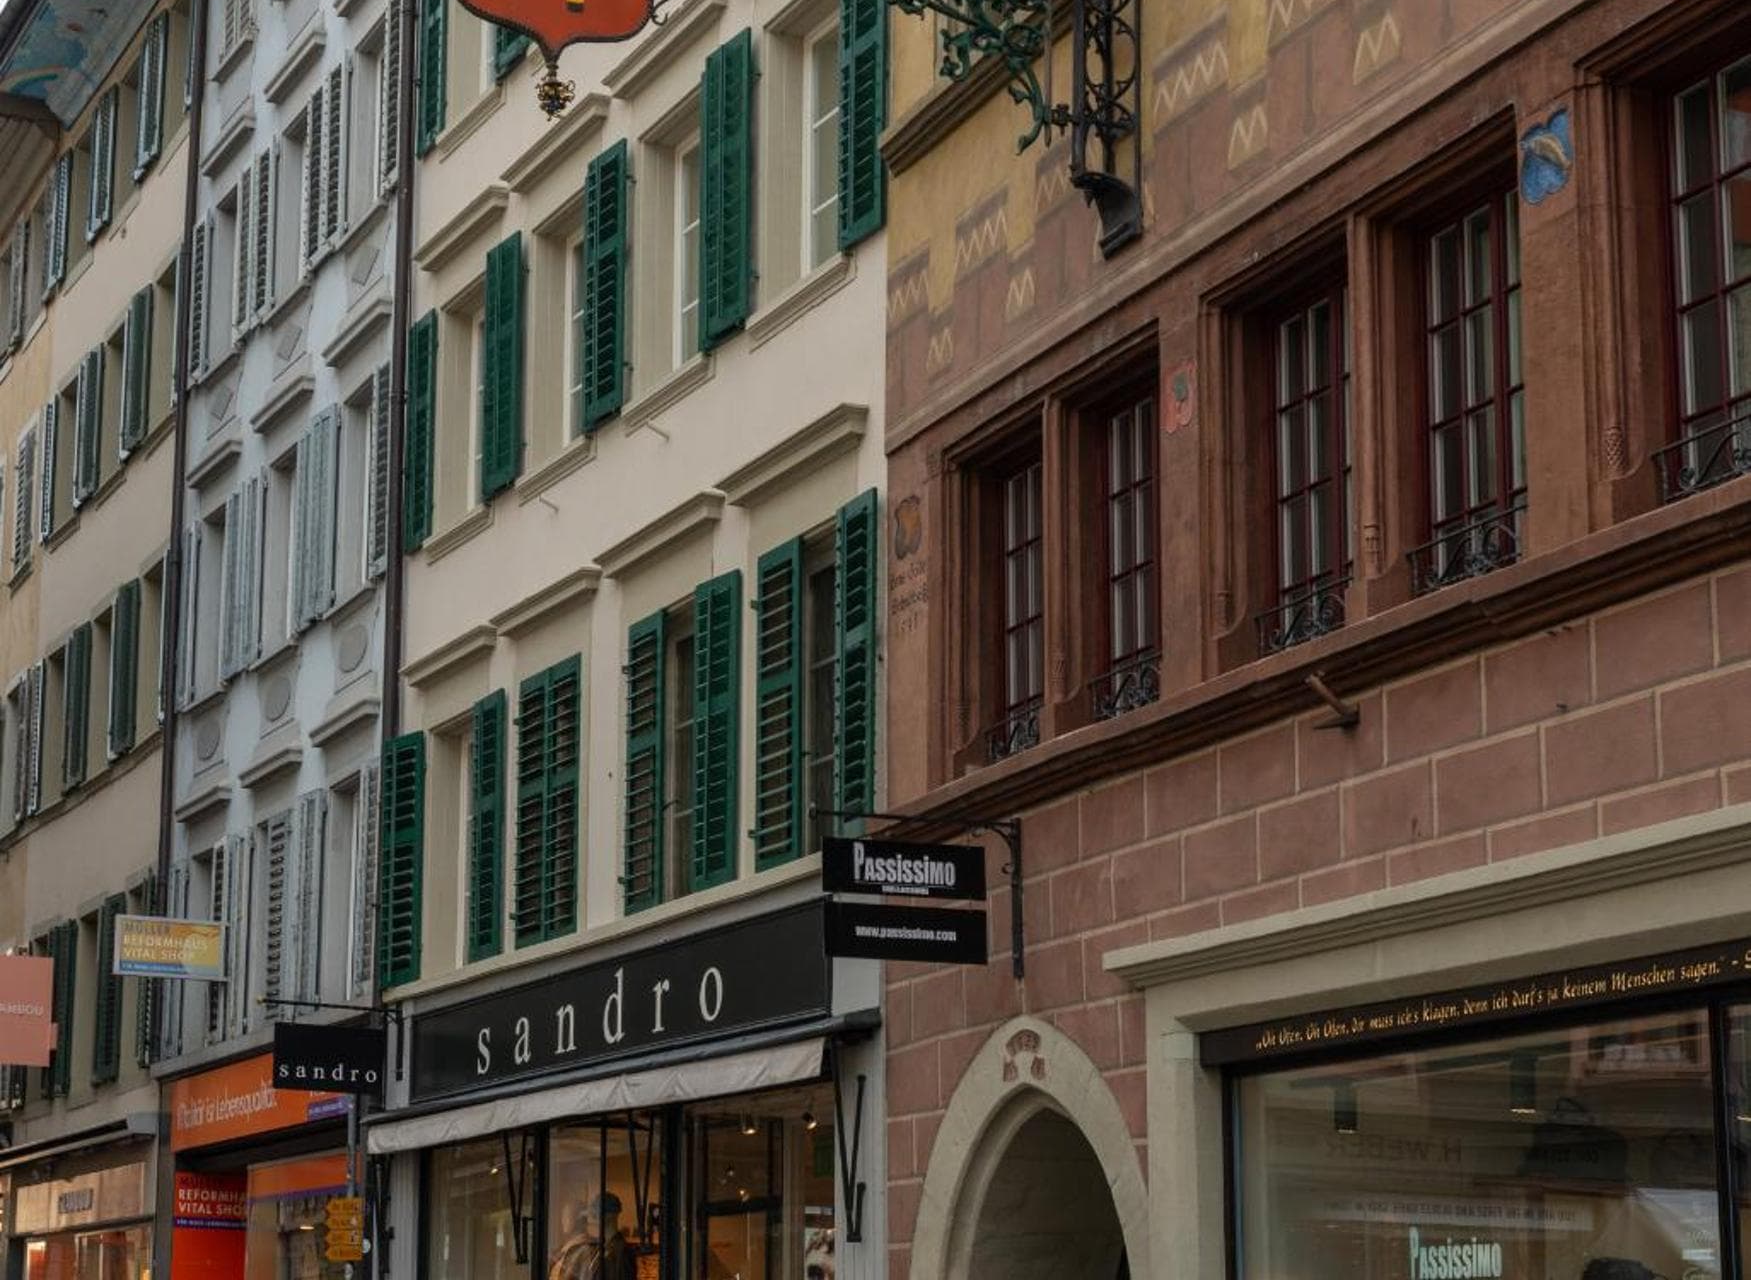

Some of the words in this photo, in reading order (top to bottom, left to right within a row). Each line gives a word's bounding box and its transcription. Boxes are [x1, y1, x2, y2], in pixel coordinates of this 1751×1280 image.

[854, 926, 957, 941] www.passissimo.com
[123, 934, 208, 950] REFORMHAUS
[123, 947, 157, 960] VITAL
[1492, 990, 1508, 1010] ich
[1562, 976, 1606, 999] keinem
[1612, 963, 1676, 992] Menschen
[476, 966, 724, 1075] sandro
[278, 1062, 378, 1084] sandro
[178, 1202, 212, 1215] VITAL
